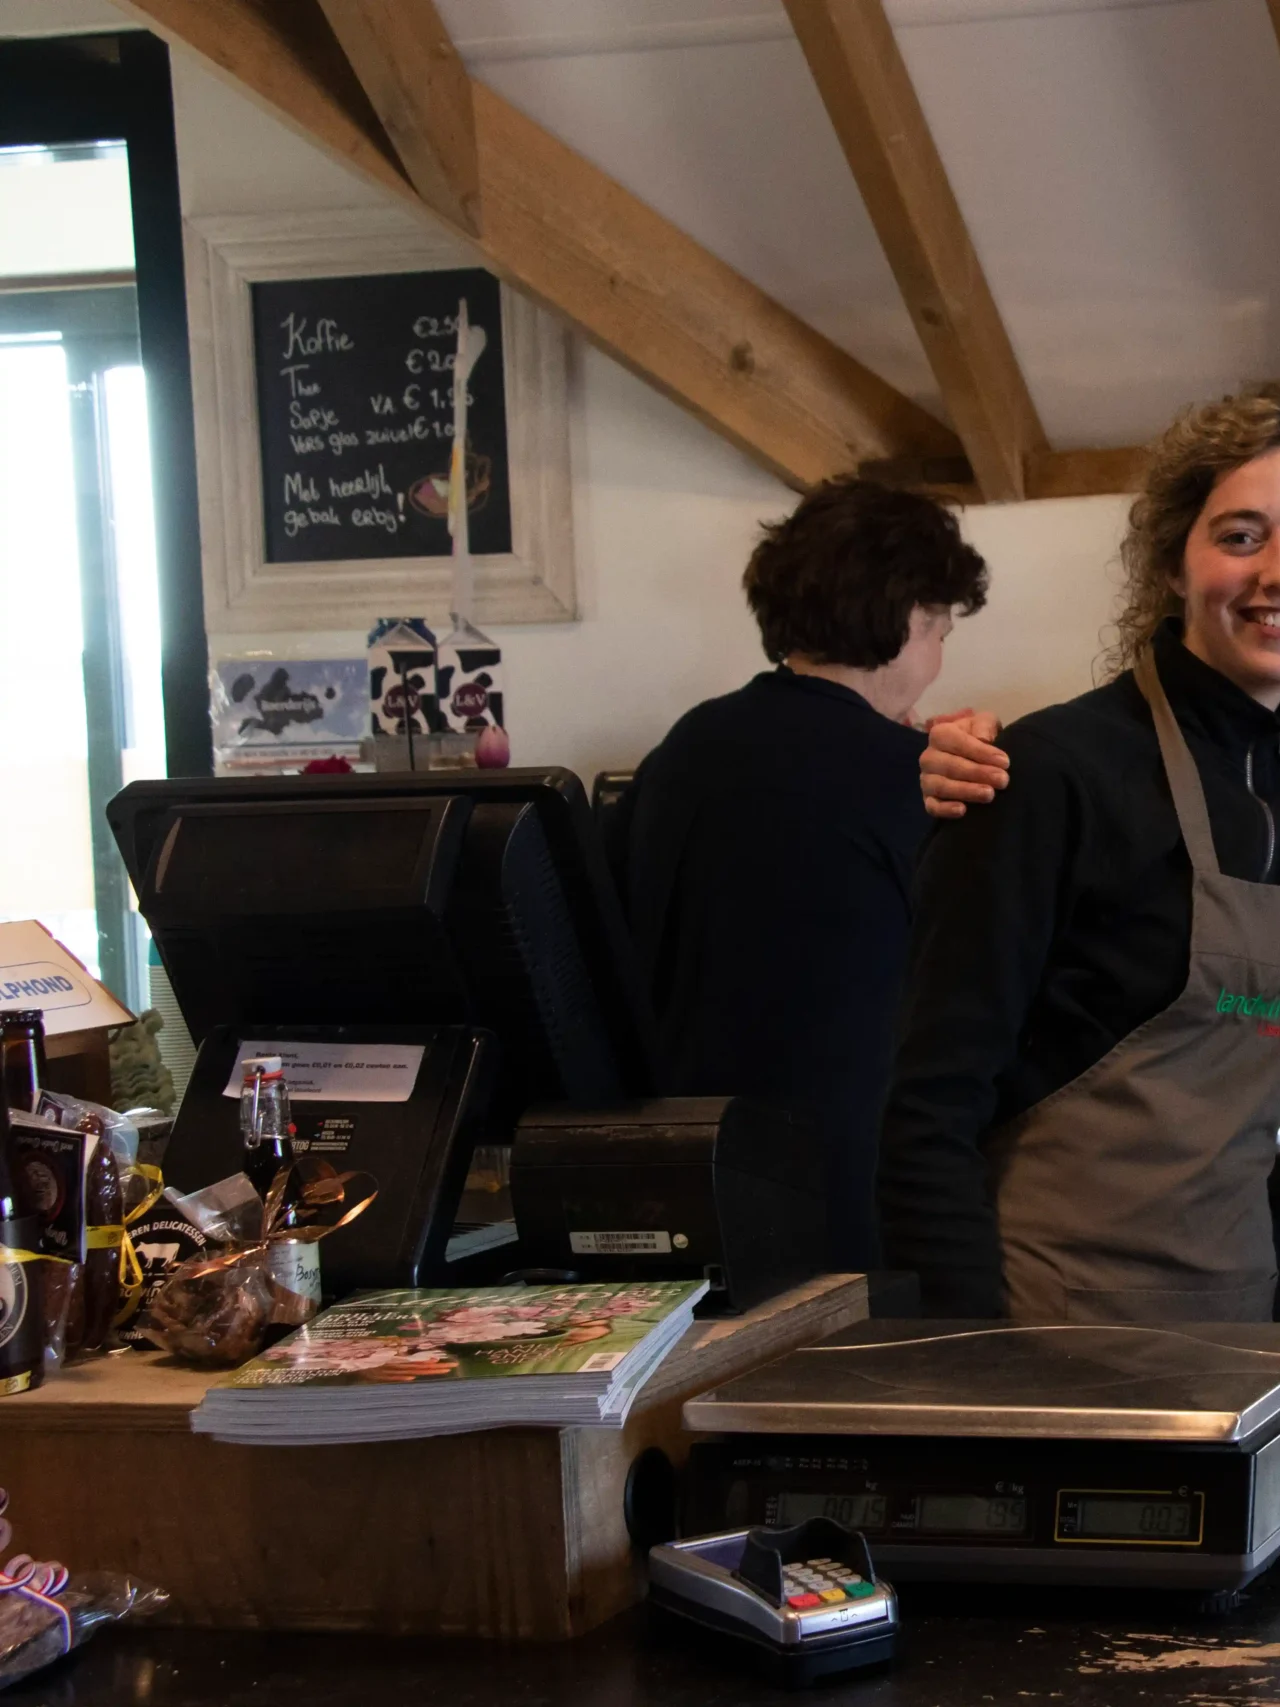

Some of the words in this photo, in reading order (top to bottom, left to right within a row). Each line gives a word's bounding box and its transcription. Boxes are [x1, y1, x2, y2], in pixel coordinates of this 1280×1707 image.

[280, 312, 355, 359] Koffie
[280, 364, 322, 398] Thee
[328, 431, 360, 456] glas
[283, 471, 320, 506] Met
[283, 505, 341, 538] gebak
[455, 694, 486, 707] L&V
[0, 975, 74, 1001] LPHOND
[152, 1220, 207, 1247] DELICATESSEN
